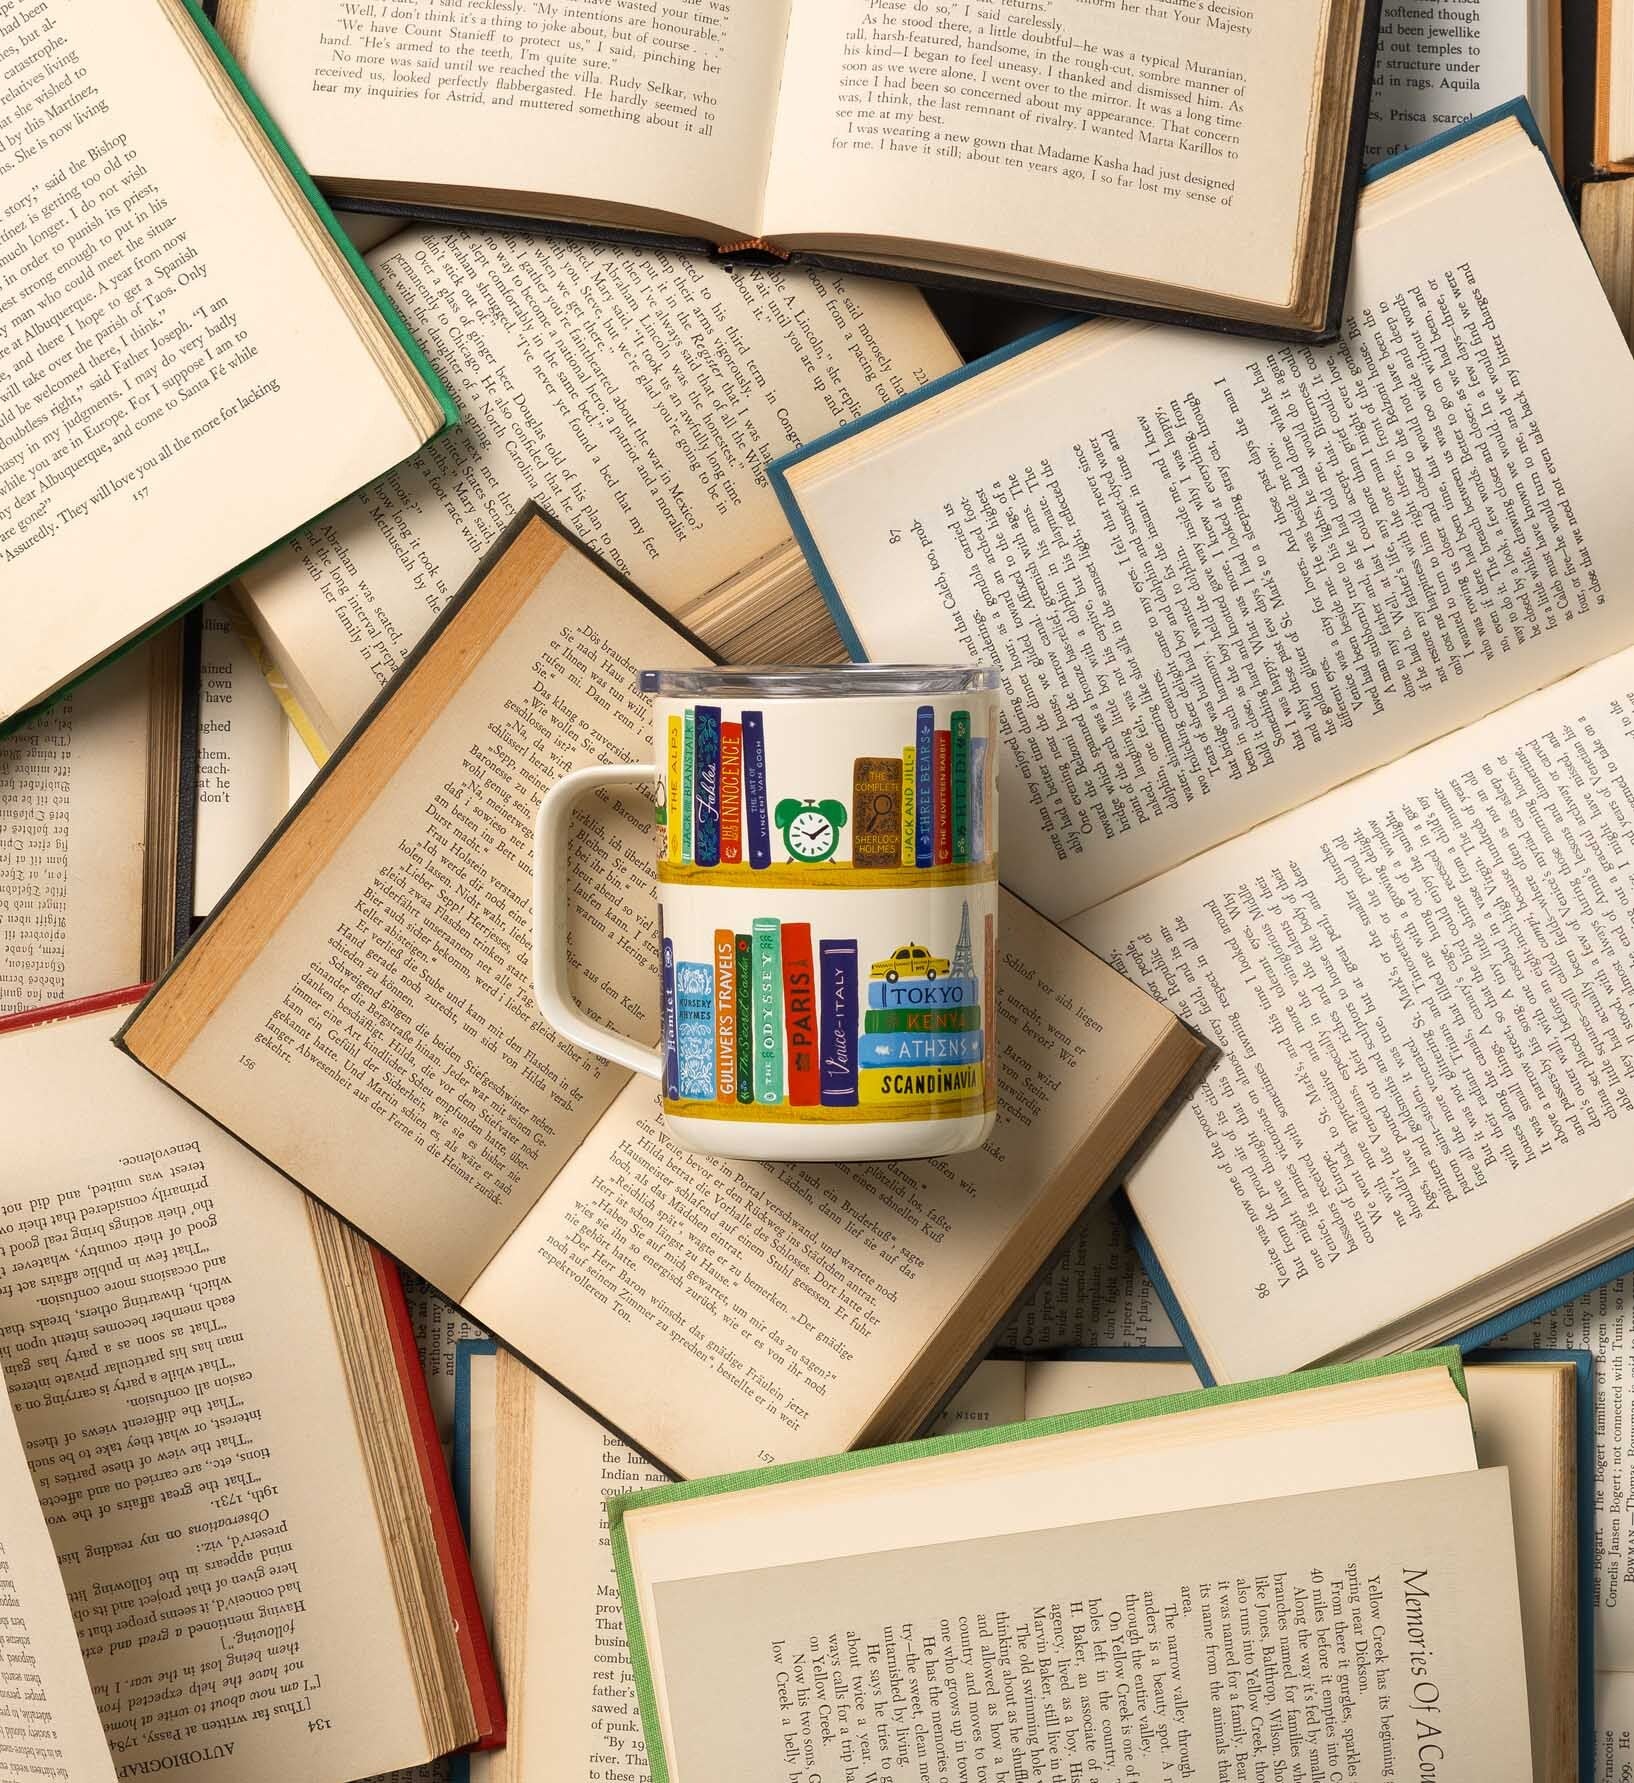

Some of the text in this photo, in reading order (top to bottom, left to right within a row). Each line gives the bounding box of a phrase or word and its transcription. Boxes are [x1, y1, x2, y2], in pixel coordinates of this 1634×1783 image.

[1389, 74, 1480, 92] in rags. Aquila
[312, 81, 712, 136] hear my inquiries for Astrid, and muttered something about it all
[857, 110, 875, 118] me
[895, 112, 913, 120] my
[918, 109, 944, 124] best.
[831, 275, 891, 372] he said morosely
[1213, 376, 1226, 386] I
[1223, 388, 1239, 414] man
[1235, 417, 1248, 436] the
[56, 501, 88, 524] They
[88, 484, 111, 504] will
[108, 471, 135, 491] love
[135, 457, 158, 479] you
[157, 444, 173, 461] all
[172, 435, 191, 451] the
[191, 416, 220, 439] more
[219, 404, 238, 421] for
[236, 378, 280, 409] lacking
[1245, 439, 1261, 465] days
[132, 485, 148, 500] 157
[1257, 468, 1276, 492] past
[1269, 495, 1287, 524] these
[888, 529, 901, 544] 87
[1279, 527, 1300, 552] And
[319, 525, 403, 645] Abraham was seated,
[1296, 556, 1316, 594] lovers.
[1311, 595, 1324, 613] for
[1320, 616, 1334, 636] city
[1334, 649, 1348, 670] was
[208, 678, 232, 689] own
[1344, 672, 1363, 711] Venice
[755, 740, 763, 768] GOGH
[721, 736, 740, 822] INNOCENCE
[920, 736, 930, 833] THREE BEARS
[695, 762, 719, 823] Fables
[904, 759, 915, 852] JACK AND JILL
[758, 794, 767, 837] VINCENT
[859, 845, 896, 853] HOLMES
[718, 942, 733, 1010] TRAVELS
[760, 952, 775, 1050] ODYSSEY
[890, 986, 963, 1004] TOKYO
[666, 990, 676, 1052] Hamlet
[679, 1010, 711, 1020] RHYMES
[790, 973, 812, 1046] PARIS
[907, 1015, 966, 1029] KENYA
[253, 1031, 291, 1063] gekehrt.
[238, 1054, 256, 1070] 156
[294, 1043, 352, 1089] Abwesenheit
[352, 1088, 369, 1103] aus
[370, 1100, 387, 1116] der
[386, 1111, 413, 1136] Ferne
[413, 1132, 424, 1146] in
[426, 1143, 440, 1158] die
[441, 1153, 474, 1183] Heimat
[473, 1181, 502, 1205] zurück-
[1322, 1150, 1374, 1243] courts of Europe.
[537, 1247, 631, 1322] respektvollerem Ton.
[1254, 1282, 1270, 1299] 86
[1611, 1315, 1624, 1351] Tunis,
[1611, 1356, 1622, 1380] with
[1611, 1386, 1622, 1442] connected
[757, 1448, 776, 1465] 157
[1612, 1446, 1621, 1464] not
[600, 1467, 639, 1480] Indian
[1607, 1518, 1622, 1557] Jansen
[1605, 1561, 1618, 1607] Cornelis
[1180, 1583, 1192, 1617] area.
[596, 1618, 624, 1632] That
[1343, 1560, 1368, 1694] spring near Dickson.
[1402, 1567, 1432, 1675] Memories
[1367, 1575, 1395, 1776] Yellow Creek has its beginning
[1408, 1681, 1440, 1712] Of
[201, 1714, 247, 1730] written
[251, 1708, 269, 1720] far
[308, 1718, 332, 1733] 134
[590, 1718, 639, 1732] of punk.
[142, 1728, 183, 1743] Passy,
[184, 1724, 197, 1736] at
[1415, 1718, 1442, 1740] A
[114, 1741, 234, 1780] AUTOBIOGRAP
